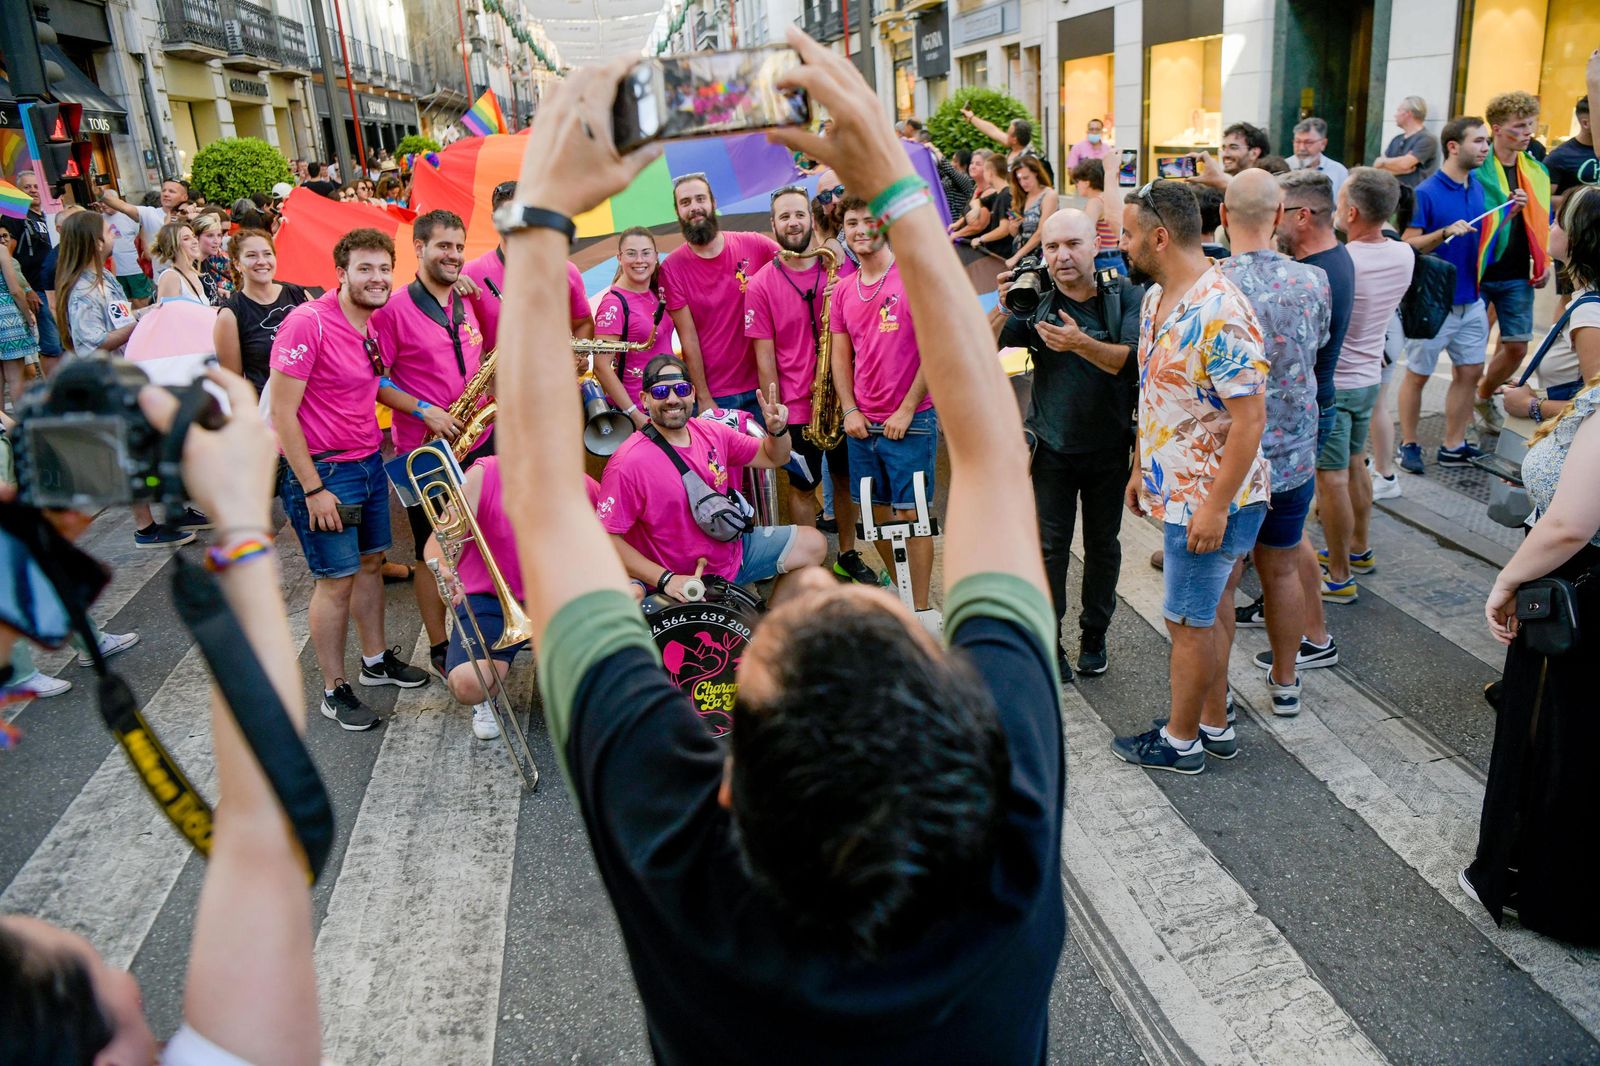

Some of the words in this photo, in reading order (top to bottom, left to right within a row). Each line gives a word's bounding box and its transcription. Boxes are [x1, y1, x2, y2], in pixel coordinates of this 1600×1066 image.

[88, 118, 110, 131] TOUS
[662, 614, 687, 628] 564
[700, 611, 725, 623] 639
[728, 619, 750, 637] 200
[701, 694, 722, 710] La
